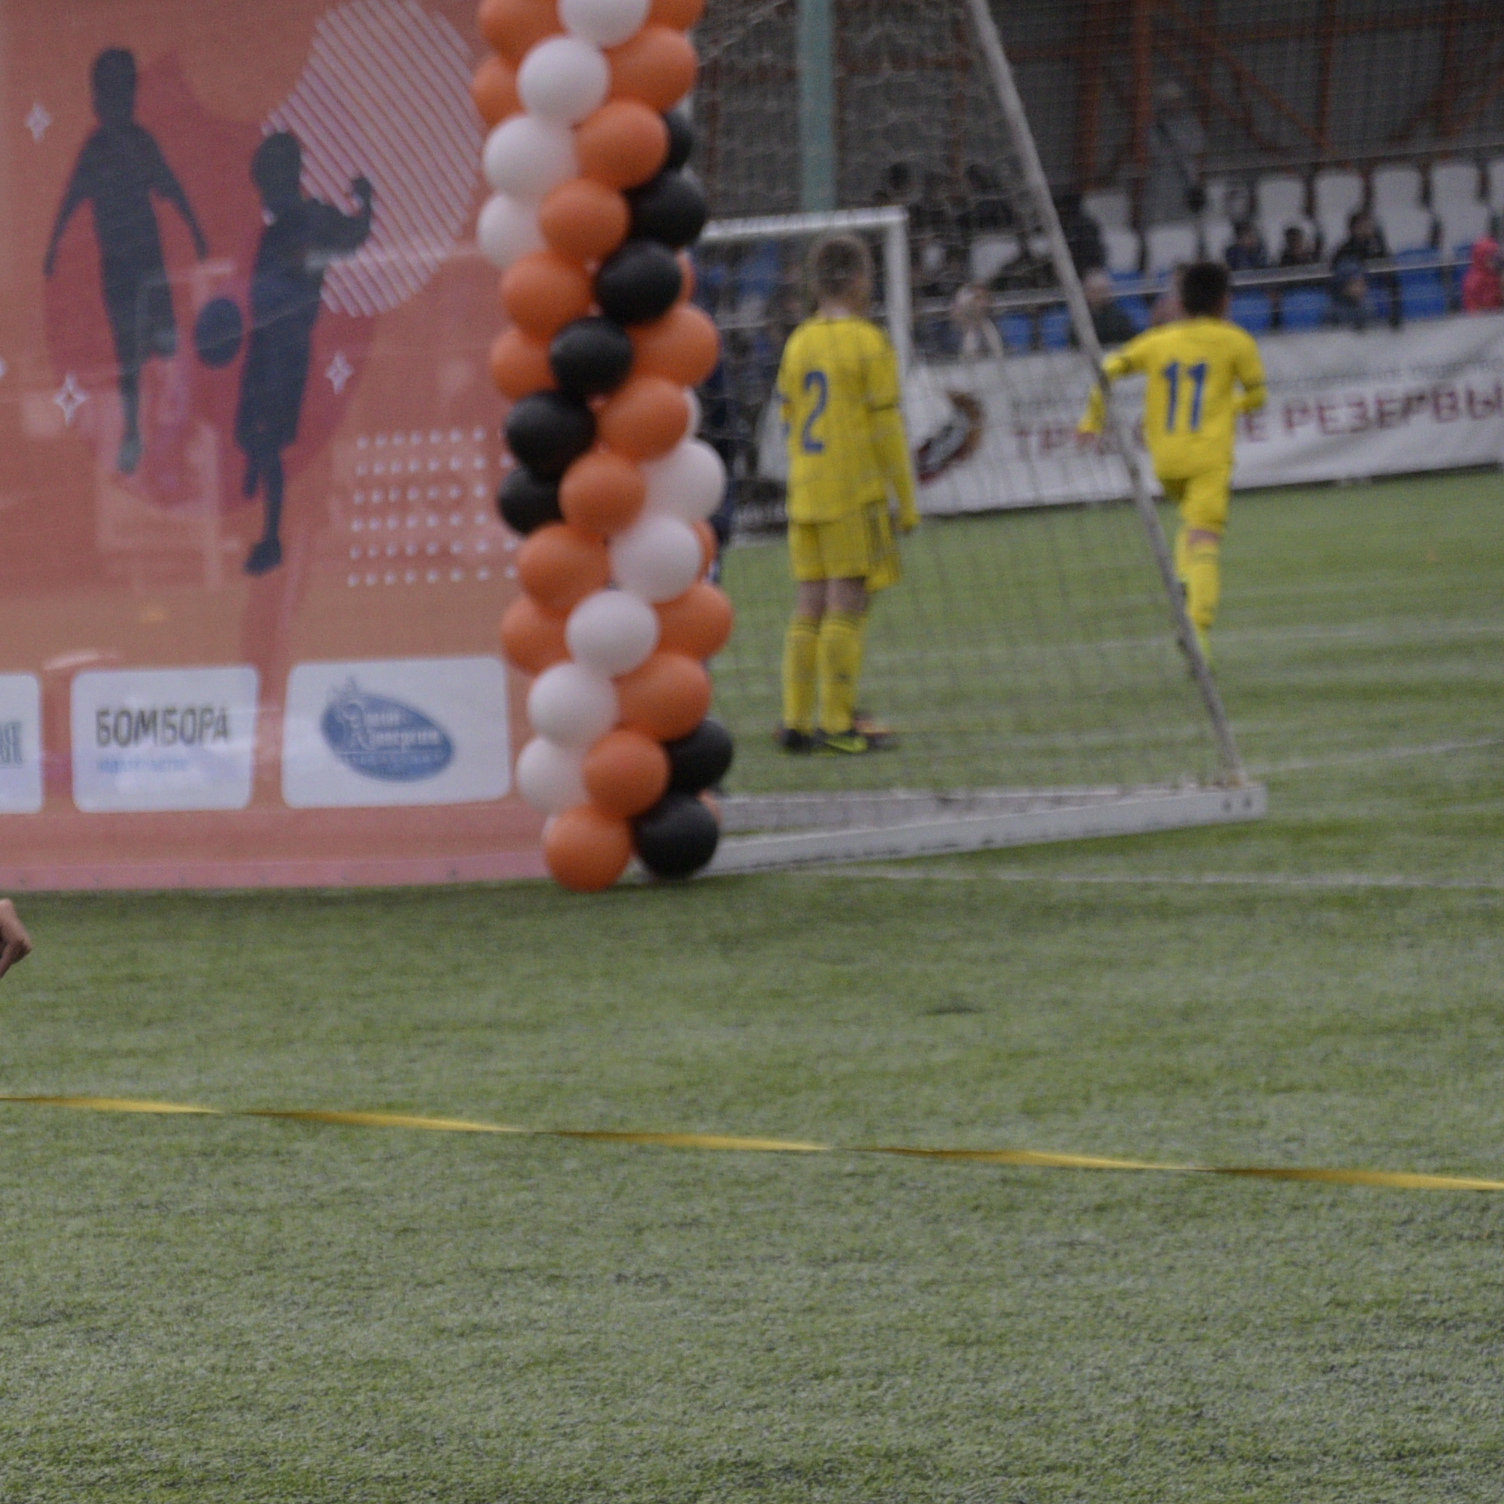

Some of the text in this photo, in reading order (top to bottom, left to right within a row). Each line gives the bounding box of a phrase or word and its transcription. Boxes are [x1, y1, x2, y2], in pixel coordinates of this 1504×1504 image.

[801, 370, 828, 453] 2
[1160, 361, 1208, 432] 11
[96, 706, 229, 746] БОМБОРА
